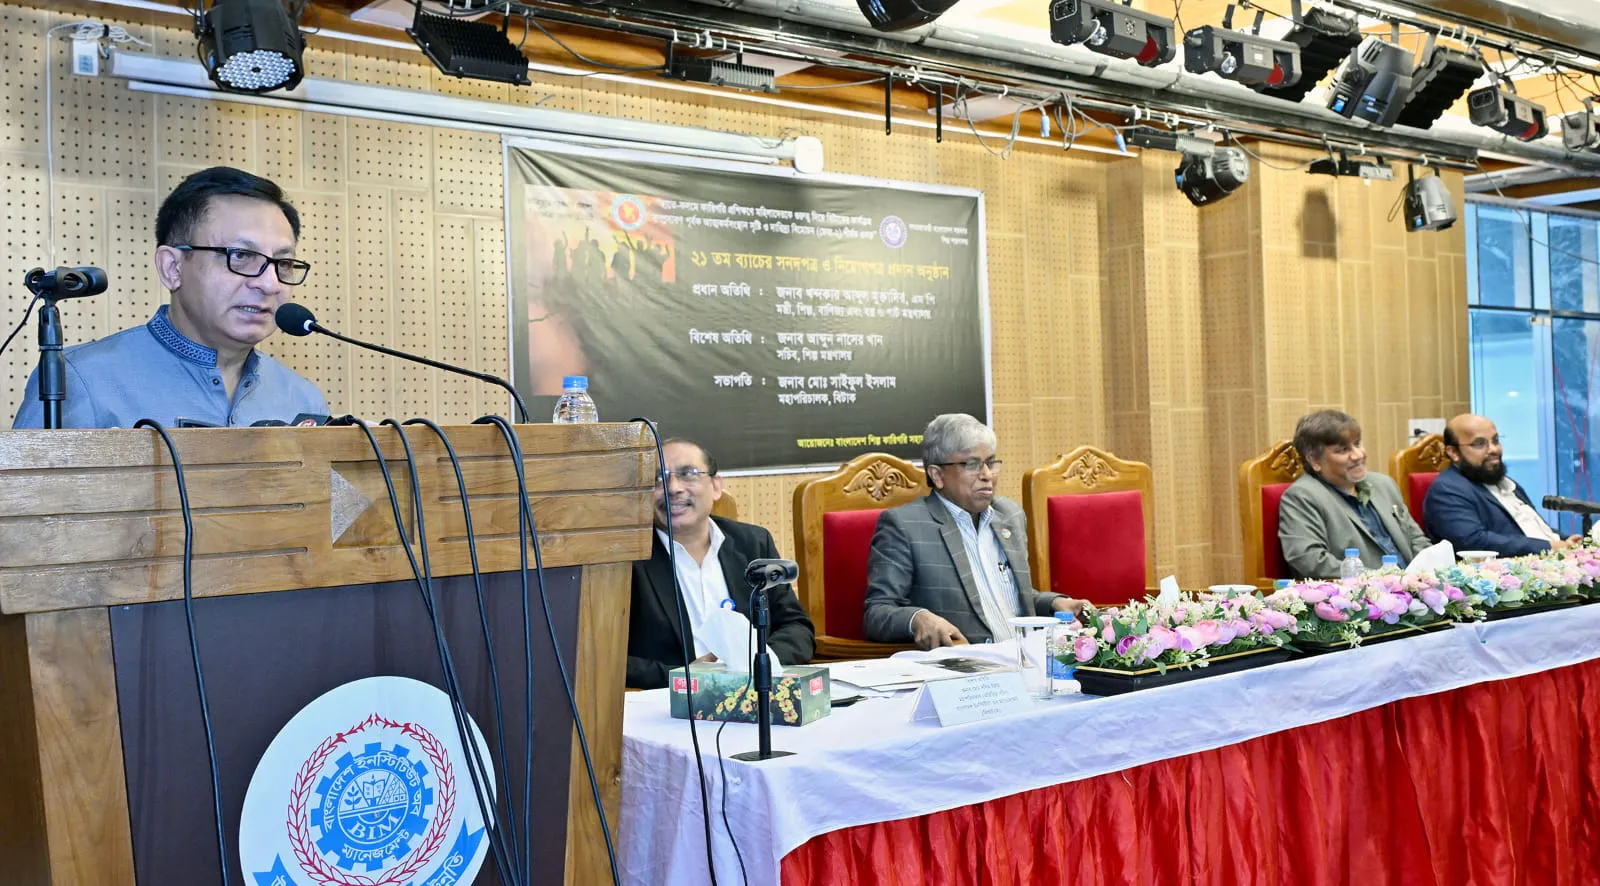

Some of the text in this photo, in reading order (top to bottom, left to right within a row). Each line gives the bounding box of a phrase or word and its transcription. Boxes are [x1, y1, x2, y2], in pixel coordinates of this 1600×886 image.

[691, 250, 708, 267] ২১
[710, 251, 731, 268] তম
[733, 252, 773, 270] ব্যাচের
[692, 283, 718, 296] প্রধান
[719, 281, 751, 297] অতিথি
[776, 286, 803, 300] জনাব
[689, 328, 719, 345] বিশেষ
[721, 329, 752, 345] অতিথি
[776, 332, 803, 346] জনাব
[713, 371, 752, 388] সভাপতি
[777, 376, 805, 389] জনাব
[807, 376, 828, 389] মোঃ
[829, 372, 864, 392] সাইফুল
[864, 372, 897, 389] ইসলাম
[832, 389, 857, 404] বিটাক
[354, 750, 421, 787] ইনস্টিটিউট
[323, 764, 355, 834] বাংলাদেশ
[346, 812, 401, 841] BIM
[341, 828, 410, 862] ম্যানেজমেন্ট
